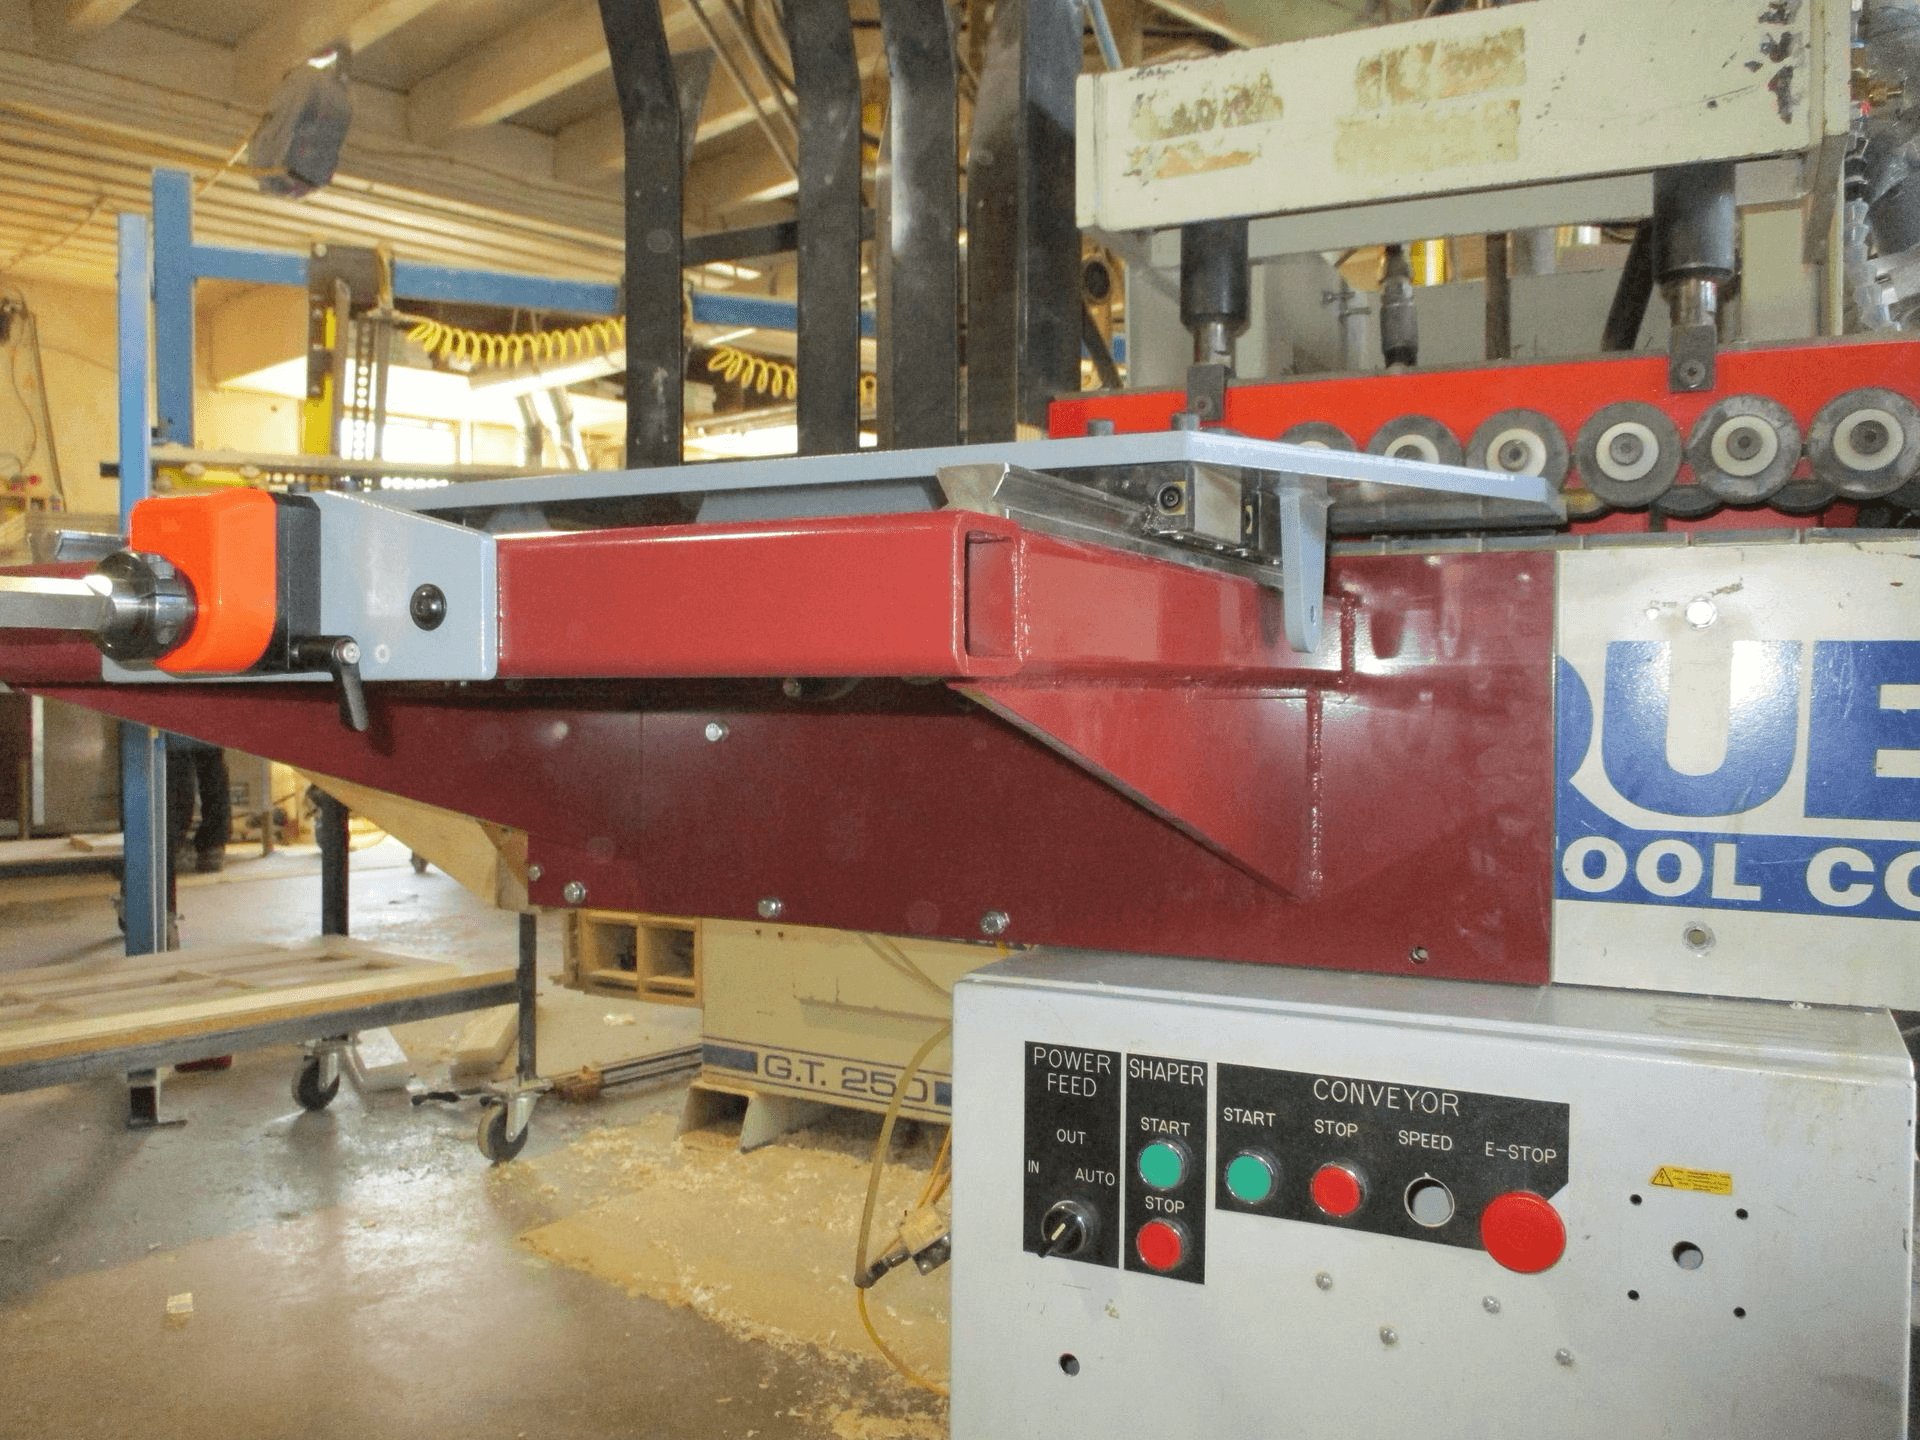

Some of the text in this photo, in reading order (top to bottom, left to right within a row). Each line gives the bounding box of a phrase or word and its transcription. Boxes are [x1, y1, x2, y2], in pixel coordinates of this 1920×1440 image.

[765, 1054, 826, 1086] G.T.
[1034, 1046, 1111, 1075] POWER
[1128, 1058, 1205, 1086] SHAPER
[1047, 1073, 1097, 1097] FEED
[1312, 1077, 1460, 1117] CONVEYOR
[1140, 1116, 1191, 1137] START
[1223, 1107, 1276, 1129] START
[1314, 1118, 1359, 1138] STOP
[1056, 1129, 1087, 1144] OUT
[1398, 1129, 1453, 1151] SPEED
[1485, 1141, 1557, 1164] E-STOP
[1028, 1159, 1040, 1175] IN
[1075, 1167, 1116, 1186] AUTO
[1145, 1195, 1186, 1213] STOP
